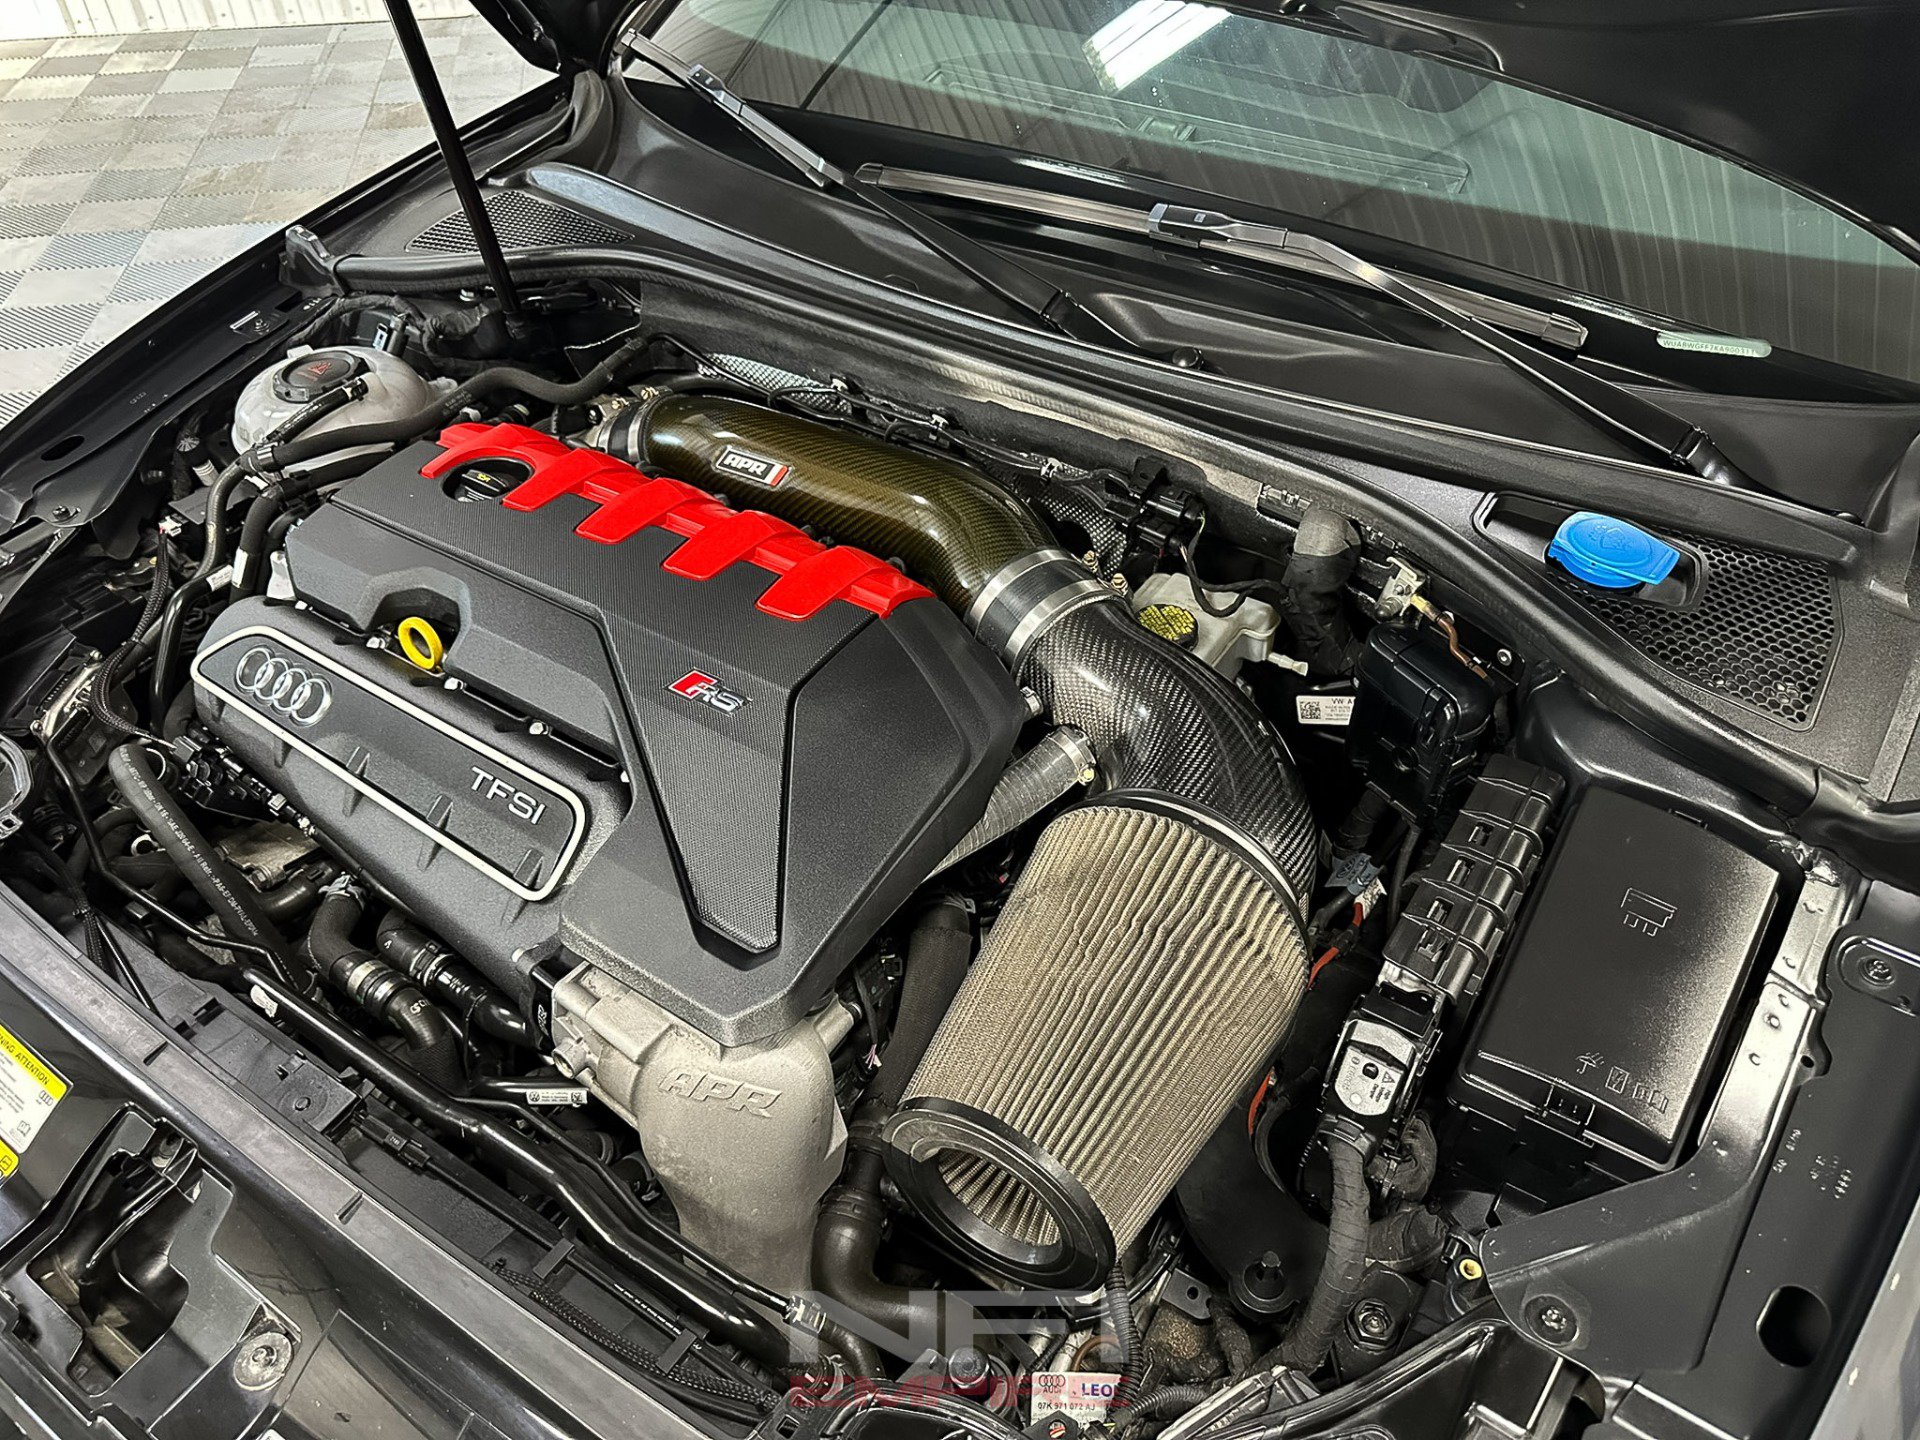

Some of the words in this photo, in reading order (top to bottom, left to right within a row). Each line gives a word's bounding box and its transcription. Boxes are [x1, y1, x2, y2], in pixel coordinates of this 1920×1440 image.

[723, 453, 768, 476] APR
[673, 673, 745, 713] RS
[471, 766, 546, 825] TFSI
[15, 1053, 50, 1085] ATTENTION
[658, 1067, 782, 1118] APR
[1054, 1402, 1067, 1410] 971
[1069, 1402, 1083, 1410] 072
